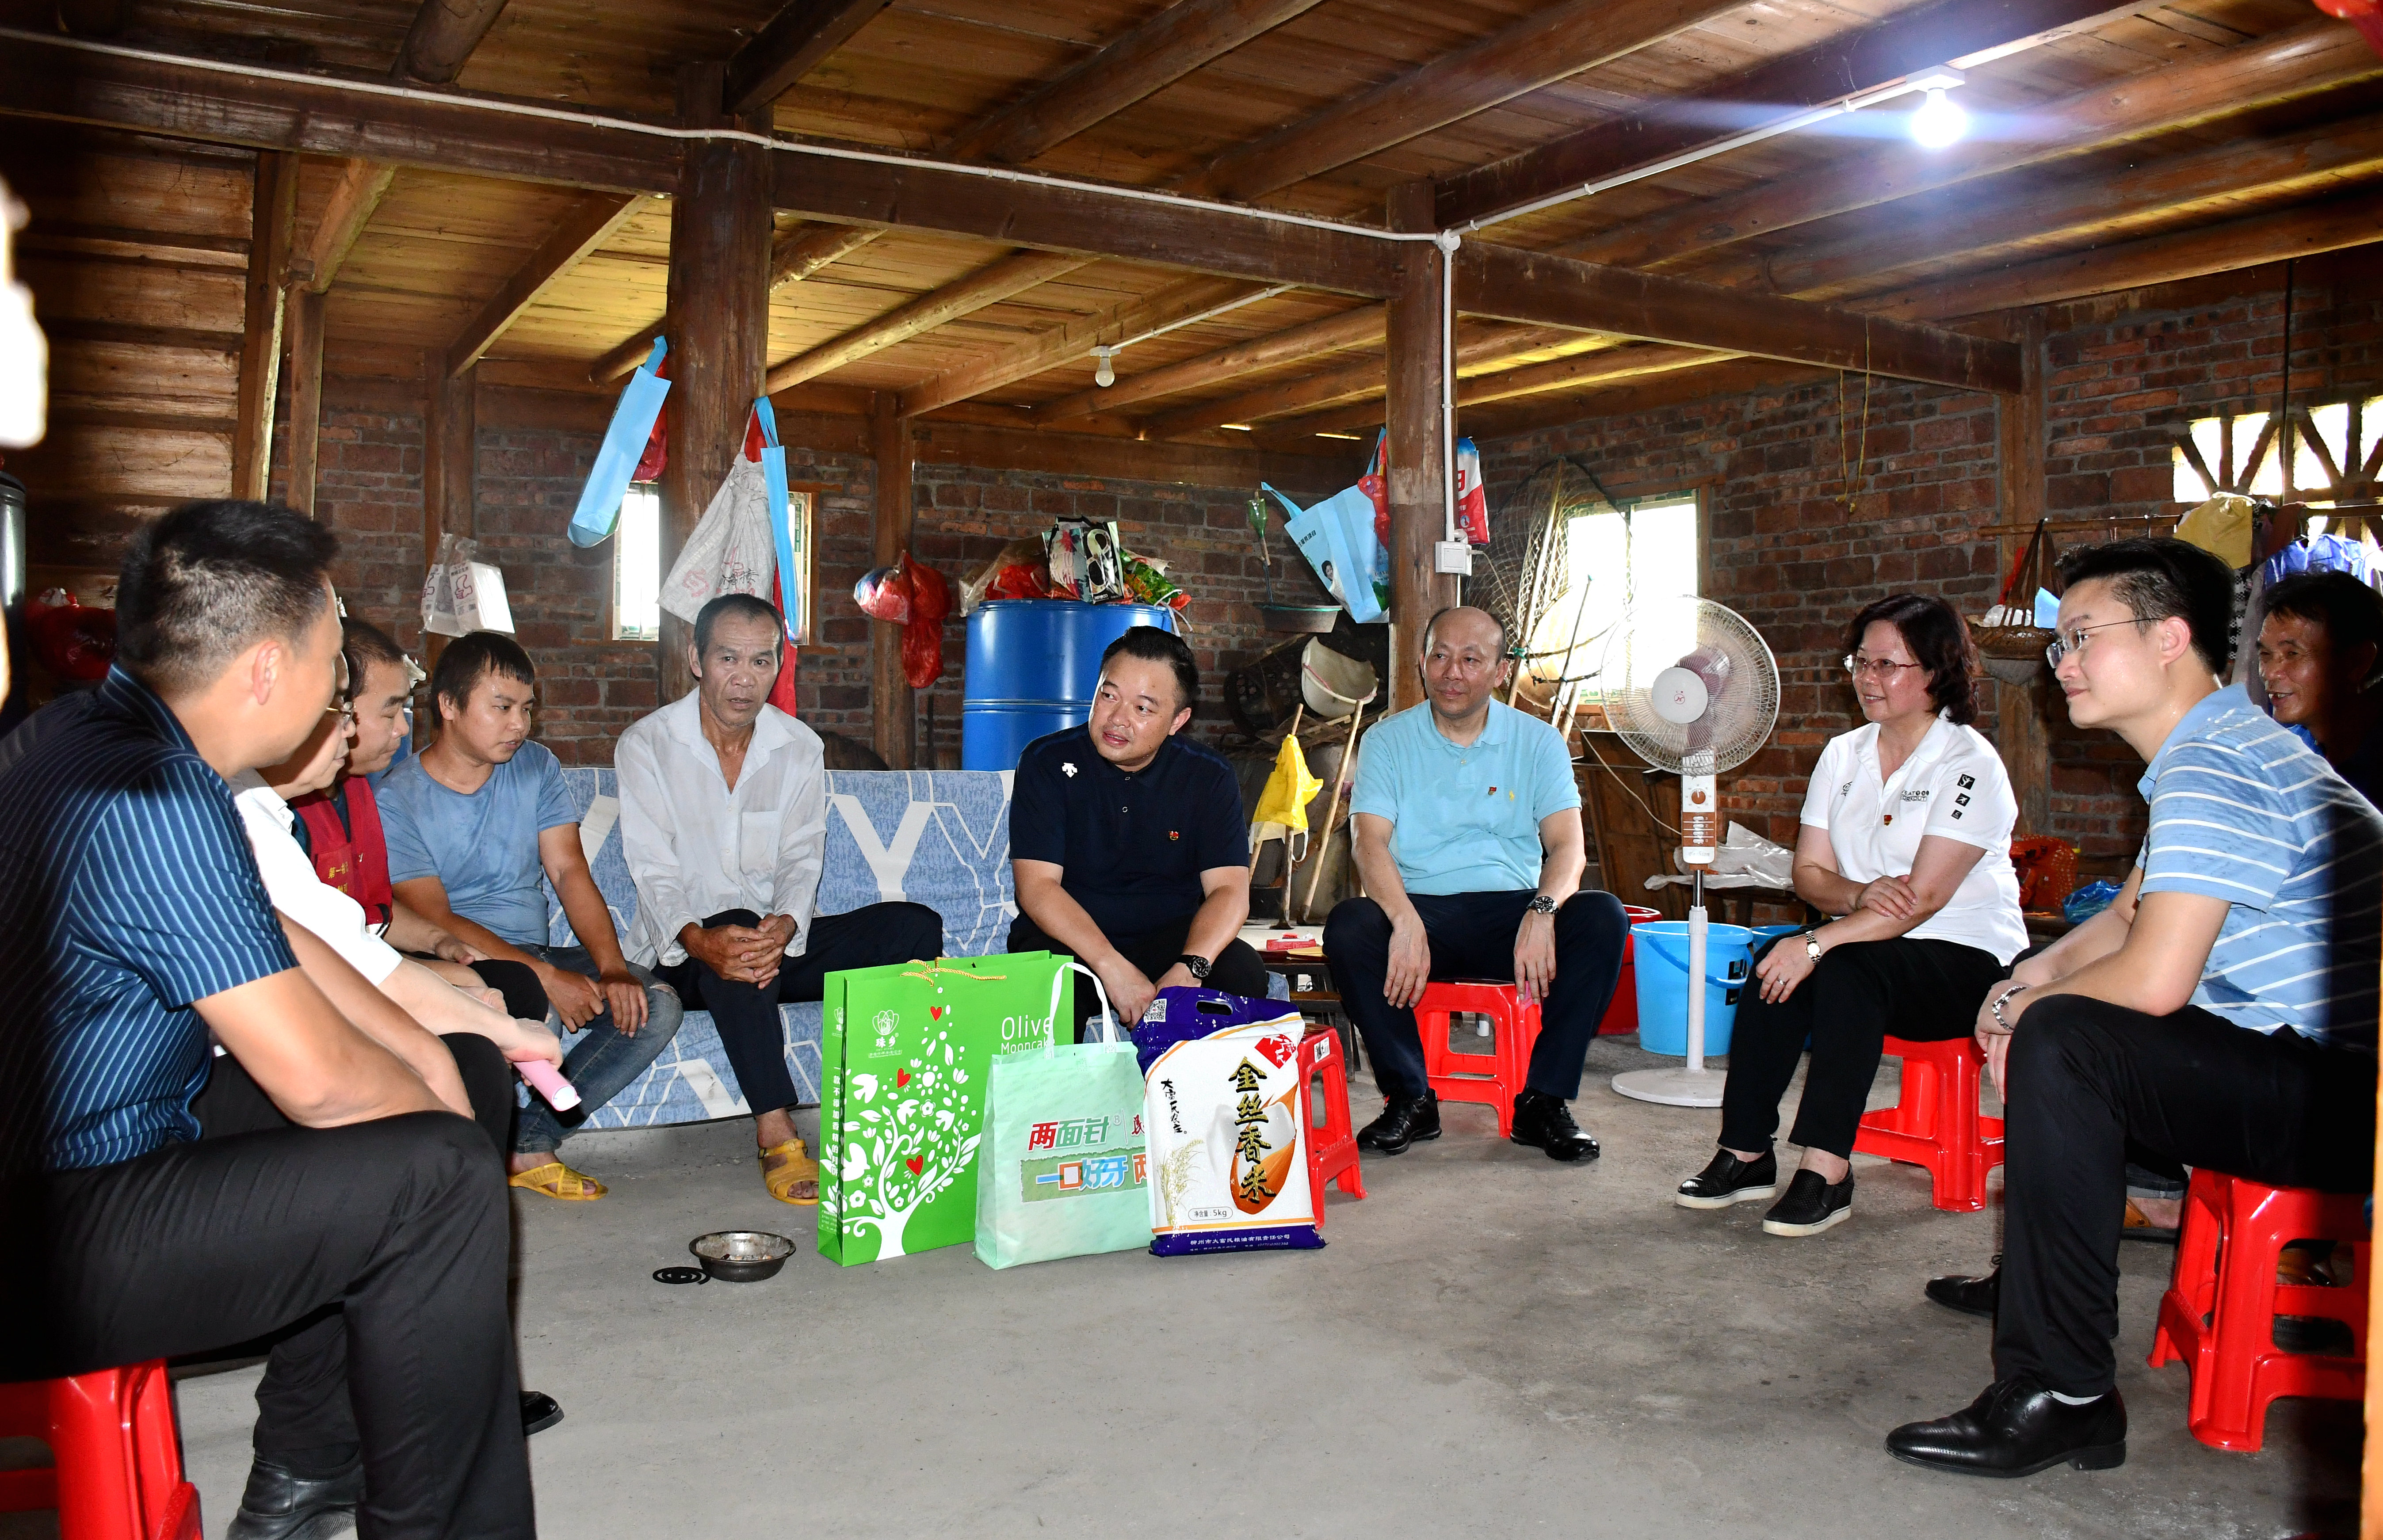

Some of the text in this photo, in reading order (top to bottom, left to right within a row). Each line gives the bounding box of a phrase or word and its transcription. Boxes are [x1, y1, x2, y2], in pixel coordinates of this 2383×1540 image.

[875, 1036, 896, 1048] 珠乡
[1027, 1116, 1109, 1151] 两面针
[1228, 1056, 1277, 1204] 金丝香米
[1037, 1155, 1128, 1189] 一口好牙
[1190, 1234, 1290, 1245] 柳州市大富民粮油有限责任公司
